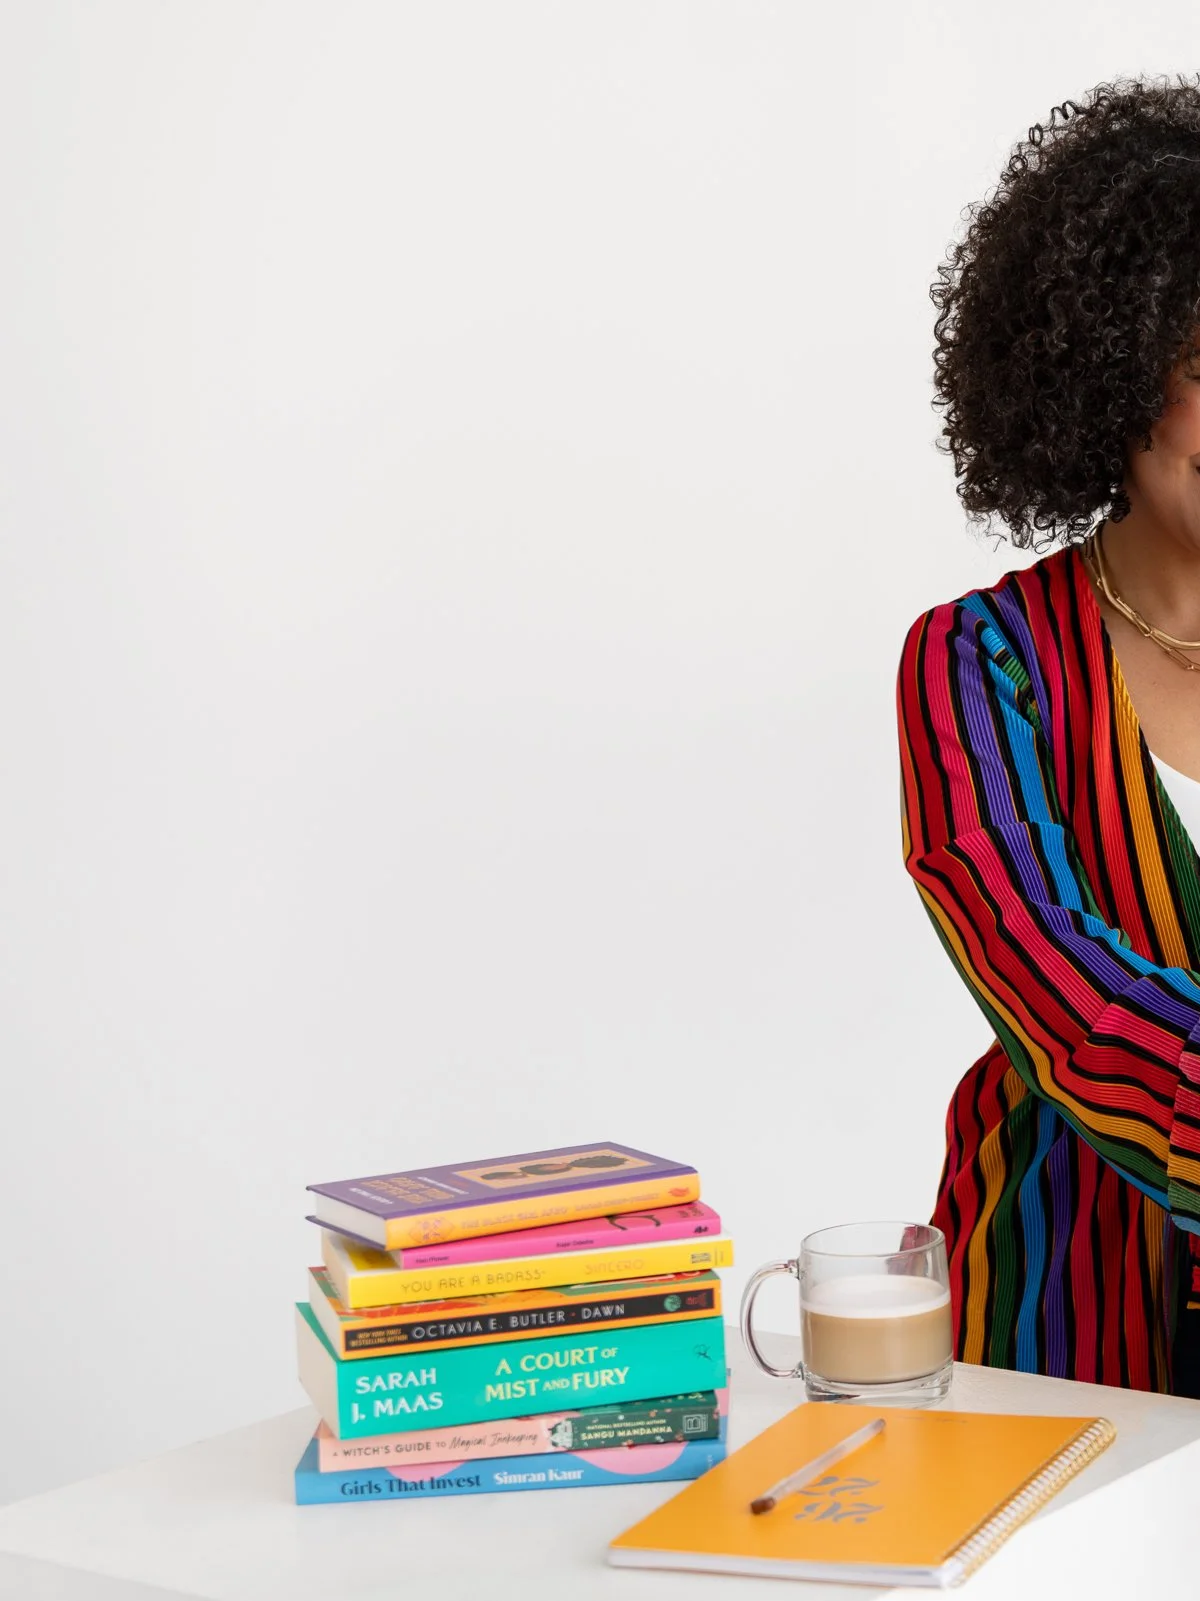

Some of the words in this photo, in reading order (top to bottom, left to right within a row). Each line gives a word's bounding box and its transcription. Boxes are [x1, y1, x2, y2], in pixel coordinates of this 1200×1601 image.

[401, 1280, 433, 1294] YOU
[439, 1275, 466, 1289] ARE
[472, 1273, 481, 1285] A
[411, 1320, 483, 1339] OCTAVIA
[488, 1317, 503, 1331] E.
[509, 1310, 566, 1328] BUTLER
[581, 1303, 625, 1320] DAWN
[495, 1359, 512, 1376] A
[520, 1346, 599, 1373] COURT
[601, 1347, 619, 1359] OF
[355, 1367, 437, 1395] SARAH
[485, 1378, 540, 1402] MIST
[542, 1378, 570, 1391] AND
[572, 1366, 630, 1390] FURY
[351, 1402, 366, 1424] J.
[374, 1392, 444, 1418] MAAS
[342, 1445, 391, 1457] WITCH'S
[395, 1441, 431, 1454] GUIDE
[449, 1435, 487, 1451] Magical
[489, 1431, 539, 1447] Innkeeping
[580, 1430, 615, 1441] SANGU
[617, 1425, 673, 1437] MANDANNA
[340, 1480, 382, 1496] Girls
[385, 1478, 425, 1492] That
[430, 1474, 481, 1489] Invest
[493, 1471, 546, 1486] Simran
[549, 1468, 585, 1481] Kaur
